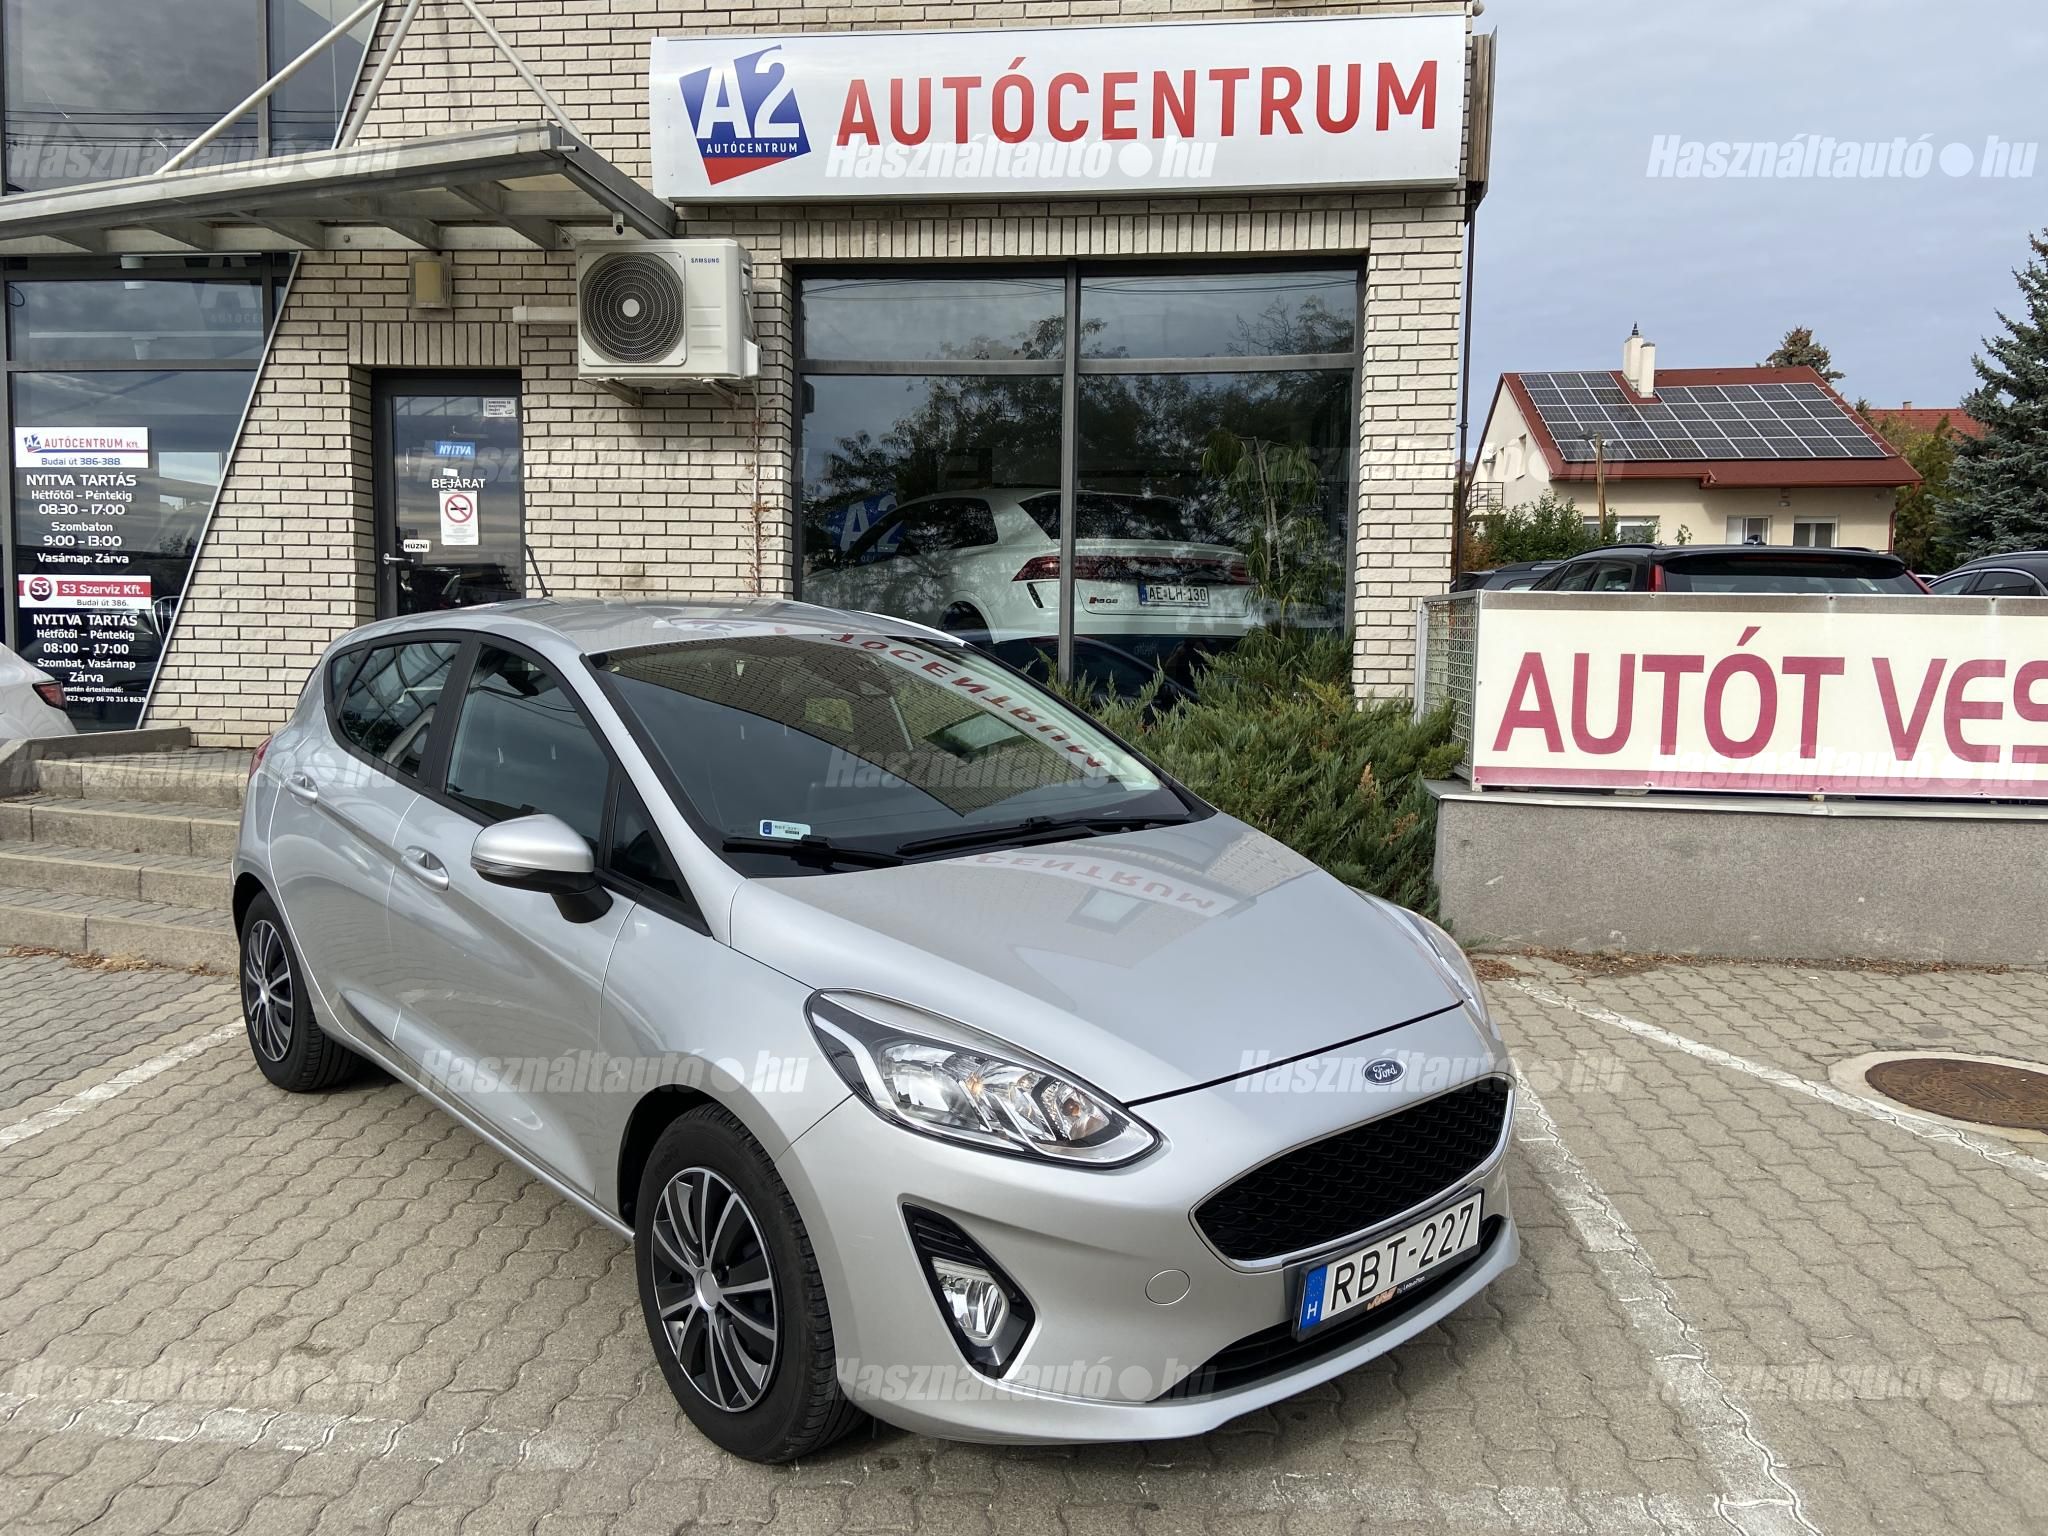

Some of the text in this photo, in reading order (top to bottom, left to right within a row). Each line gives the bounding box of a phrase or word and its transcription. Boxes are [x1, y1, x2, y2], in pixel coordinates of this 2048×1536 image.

[696, 48, 800, 138] A2
[836, 56, 1438, 146] AUTÓCENTRUM
[706, 140, 798, 154] AUTÓCENTRUM
[44, 436, 123, 448] AUTÓCENTRUM
[42, 458, 66, 466] Budai
[26, 472, 136, 486] NYITVA TARTÁS
[32, 489, 74, 500] Hétfőtől
[86, 490, 132, 502] Péntekig
[38, 504, 78, 515] 08:30
[91, 504, 125, 515] 17:00
[51, 521, 113, 532] Szombaton
[43, 535, 75, 546] 9:00
[88, 536, 122, 546] 13:00
[37, 552, 129, 565] Vasárnap: Zárva
[32, 580, 49, 595] S3
[62, 584, 144, 594] S3 Szerviz Kft.
[33, 612, 138, 626] NYITVA TARTÁS
[36, 629, 78, 639] Hétfőtől
[90, 630, 135, 641] Péntekig
[43, 643, 78, 653] 08:00
[94, 644, 129, 654] 17:00
[37, 658, 136, 670] Szombat, Vasárnap
[70, 672, 104, 682] Zárva
[1492, 626, 1846, 760] AUTÓT
[1372, 1063, 1398, 1080] Ford
[1331, 1202, 1474, 1311] RBT-227
[1306, 1302, 1318, 1320] H
